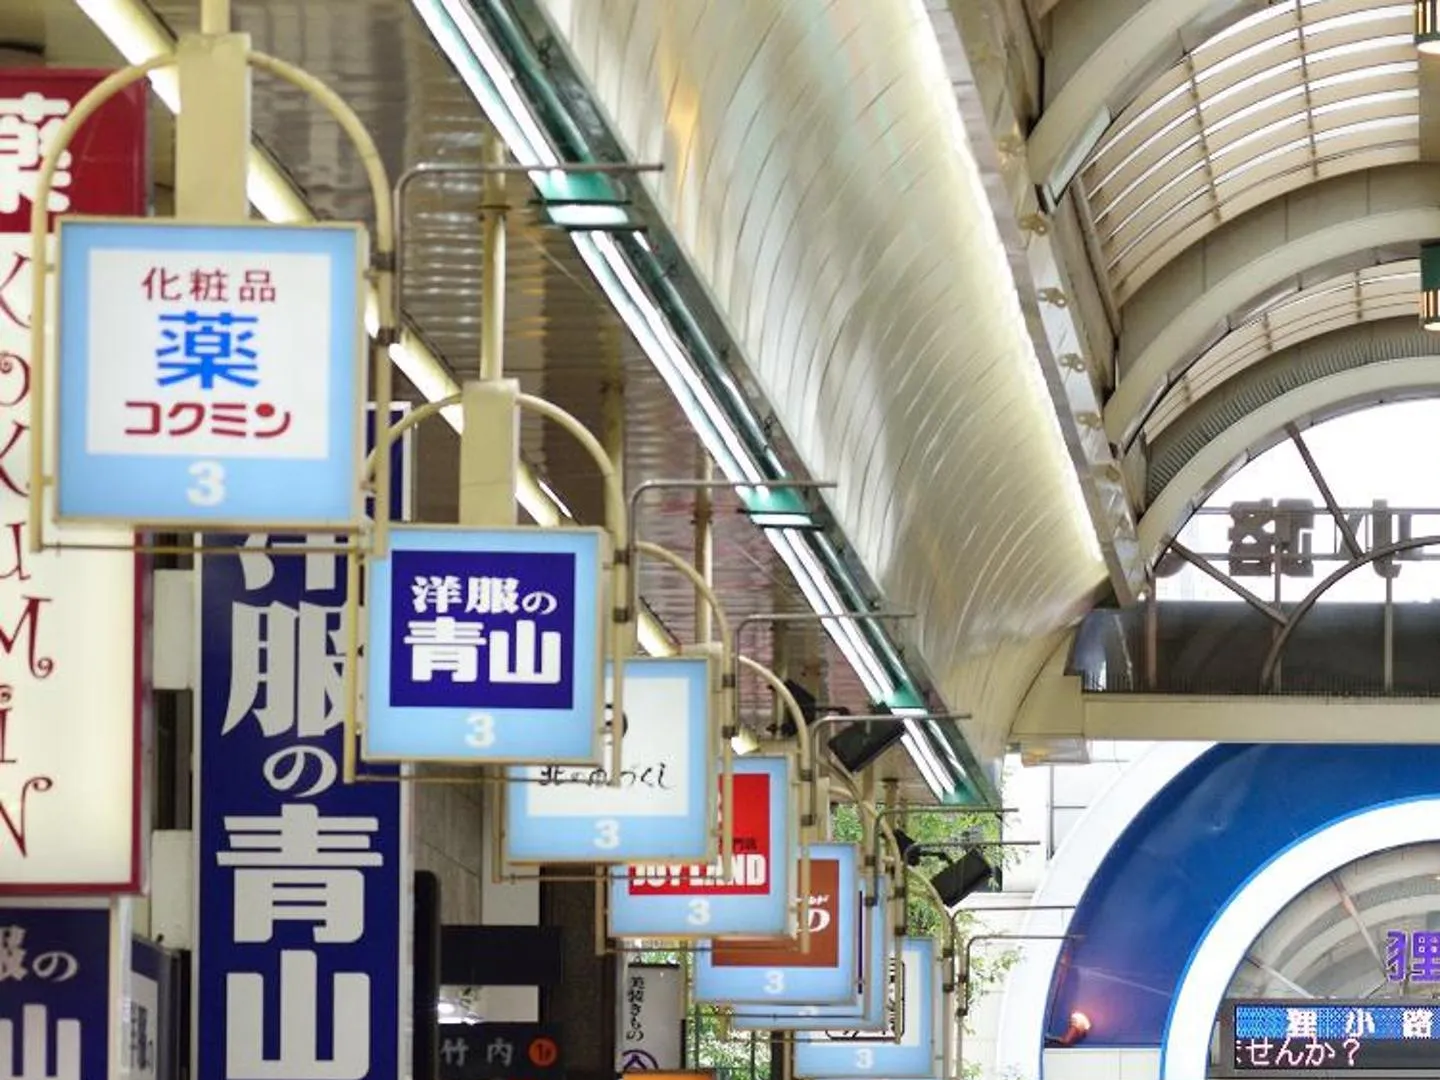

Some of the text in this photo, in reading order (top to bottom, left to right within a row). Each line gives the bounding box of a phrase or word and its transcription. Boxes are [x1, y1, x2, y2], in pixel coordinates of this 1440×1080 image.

[141, 266, 276, 303] 化粧品
[155, 310, 260, 389] 薬
[124, 401, 292, 439] コクミン
[187, 460, 227, 507] 3
[411, 574, 557, 614] 洋服の
[403, 615, 562, 685] 青山
[466, 712, 496, 747] 3
[593, 819, 620, 849] 3
[688, 898, 711, 926] 3
[763, 969, 785, 994] 3
[855, 1047, 874, 1069] 3
[1236, 1038, 1361, 1067] せんか？
